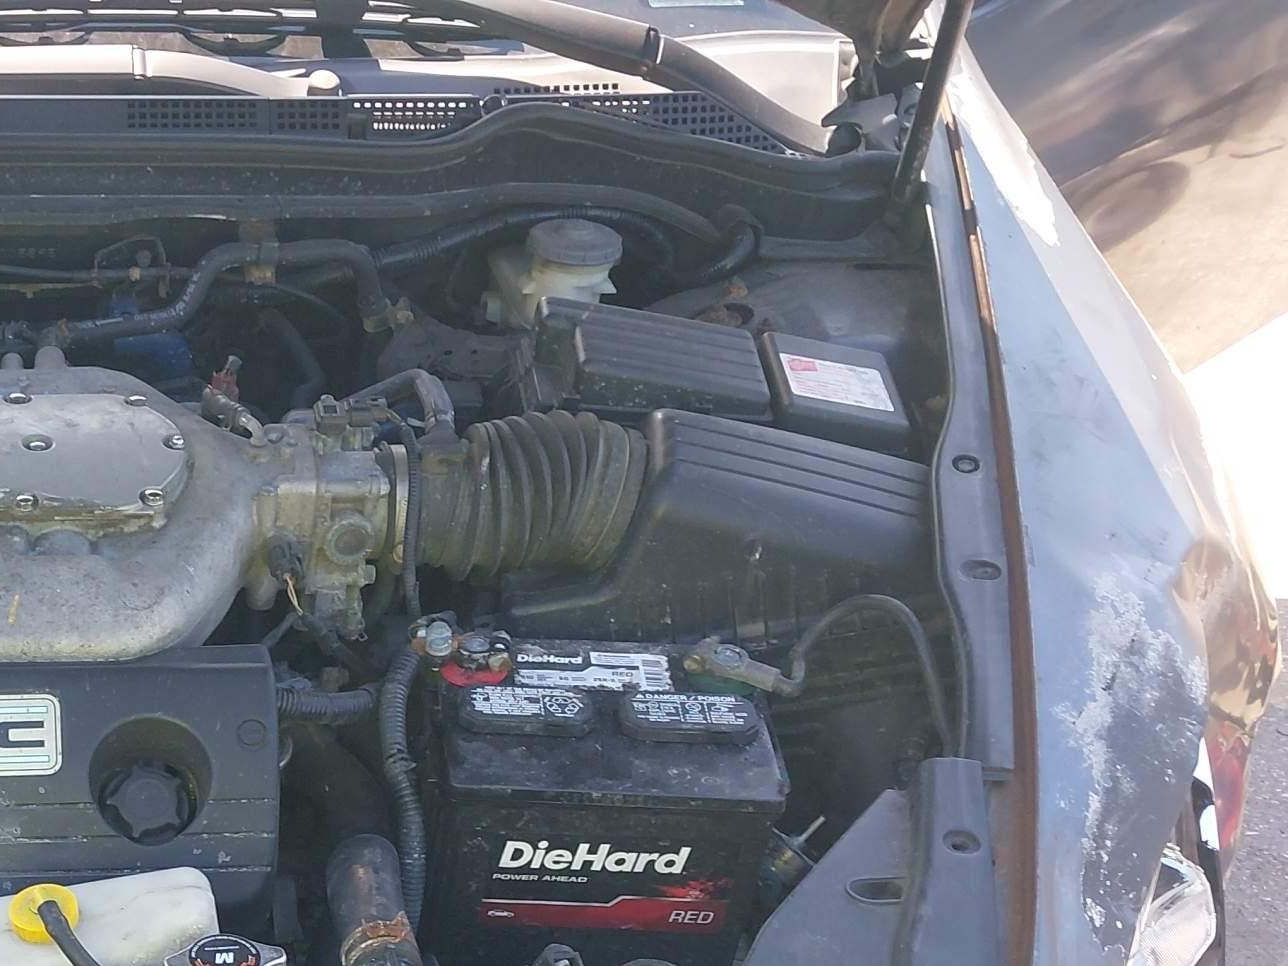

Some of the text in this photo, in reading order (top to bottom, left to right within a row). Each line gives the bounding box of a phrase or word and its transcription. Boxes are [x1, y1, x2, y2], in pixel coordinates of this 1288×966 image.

[516, 653, 583, 665] DieHard
[645, 693, 688, 701] DANGER
[498, 840, 692, 874] DieHard
[492, 873, 588, 883] POWER AHEAD
[668, 910, 715, 924] RED
